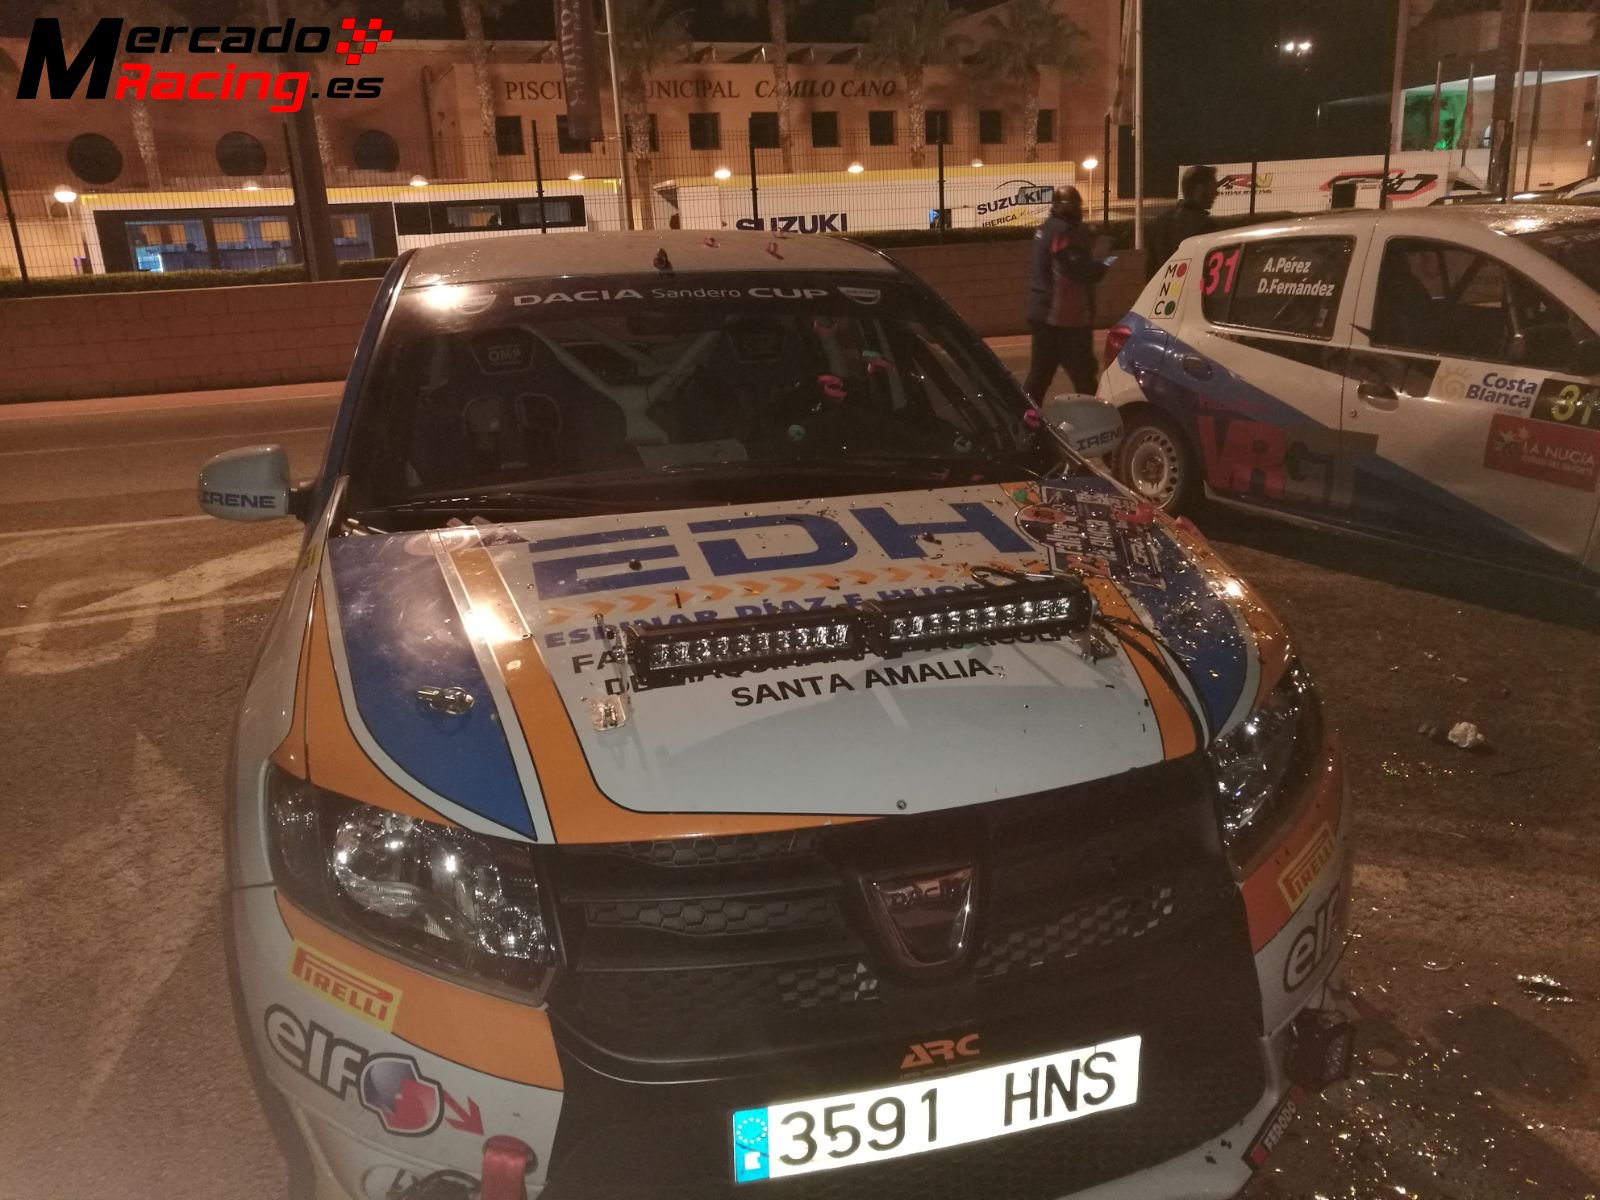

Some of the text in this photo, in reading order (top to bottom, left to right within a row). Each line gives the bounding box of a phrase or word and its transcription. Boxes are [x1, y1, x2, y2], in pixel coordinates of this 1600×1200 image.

[506, 81, 563, 99] PISCI
[840, 79, 897, 98] CANO
[977, 190, 1040, 215] SUZUKI
[1200, 249, 1240, 296] 31
[1263, 256, 1312, 273] A.Pérez
[514, 287, 829, 306] DACIA Sandero CUP
[1257, 278, 1335, 297] D.Fernández
[1465, 384, 1532, 409] Blanca
[1483, 372, 1538, 394] Costa
[201, 490, 277, 508] IRENE
[529, 502, 1038, 600] EDH
[731, 657, 994, 707] SANTA AMALIA
[291, 946, 395, 1022] PIRELLI
[263, 1003, 372, 1101] elf
[900, 1032, 980, 1069] ARC
[779, 1051, 1117, 1167] 3591 HNS
[1263, 1100, 1297, 1153] FERODO
